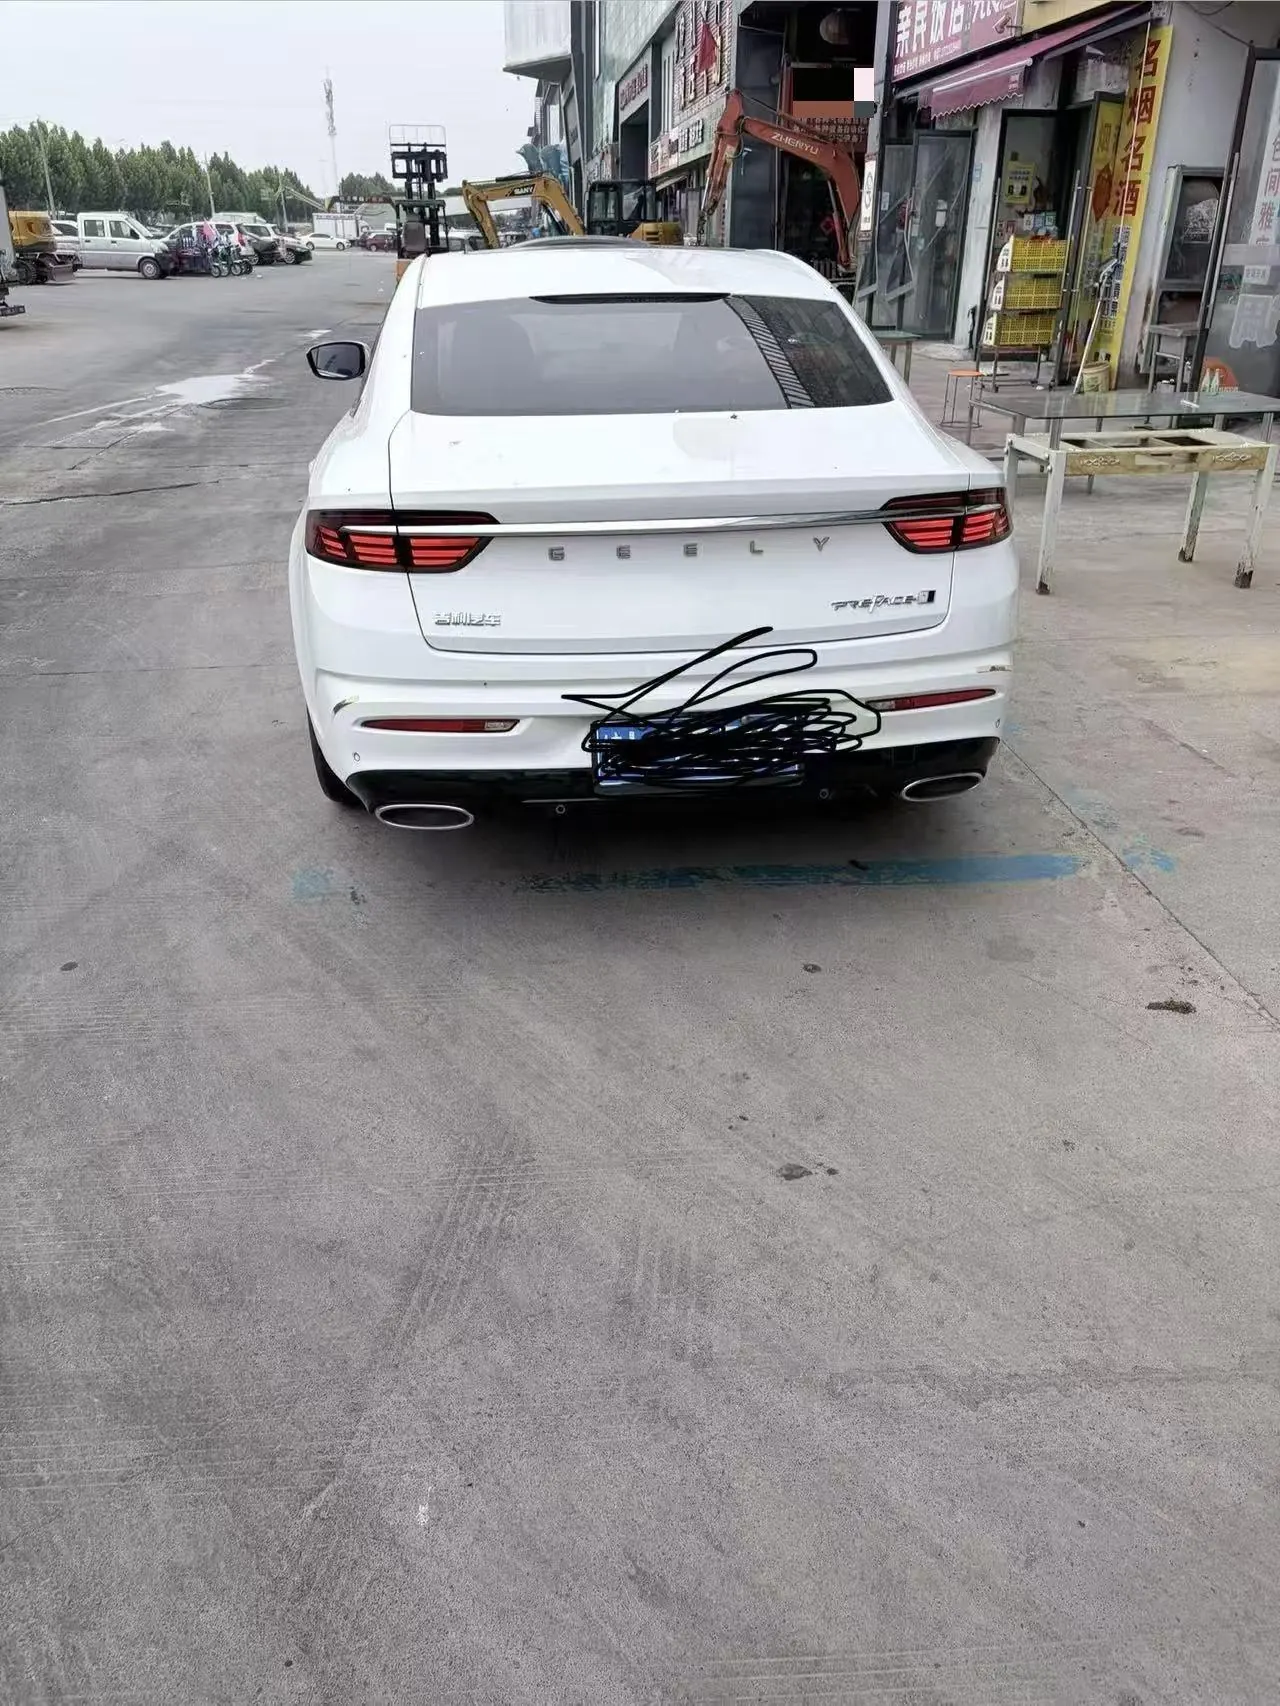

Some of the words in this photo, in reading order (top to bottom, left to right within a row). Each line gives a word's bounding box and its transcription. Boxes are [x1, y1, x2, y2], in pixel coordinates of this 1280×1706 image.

[1112, 38, 1161, 217] 名烟名酒
[772, 132, 819, 154] ZHENYU
[549, 536, 830, 561] GEELY
[434, 611, 501, 627] 吉利汽车
